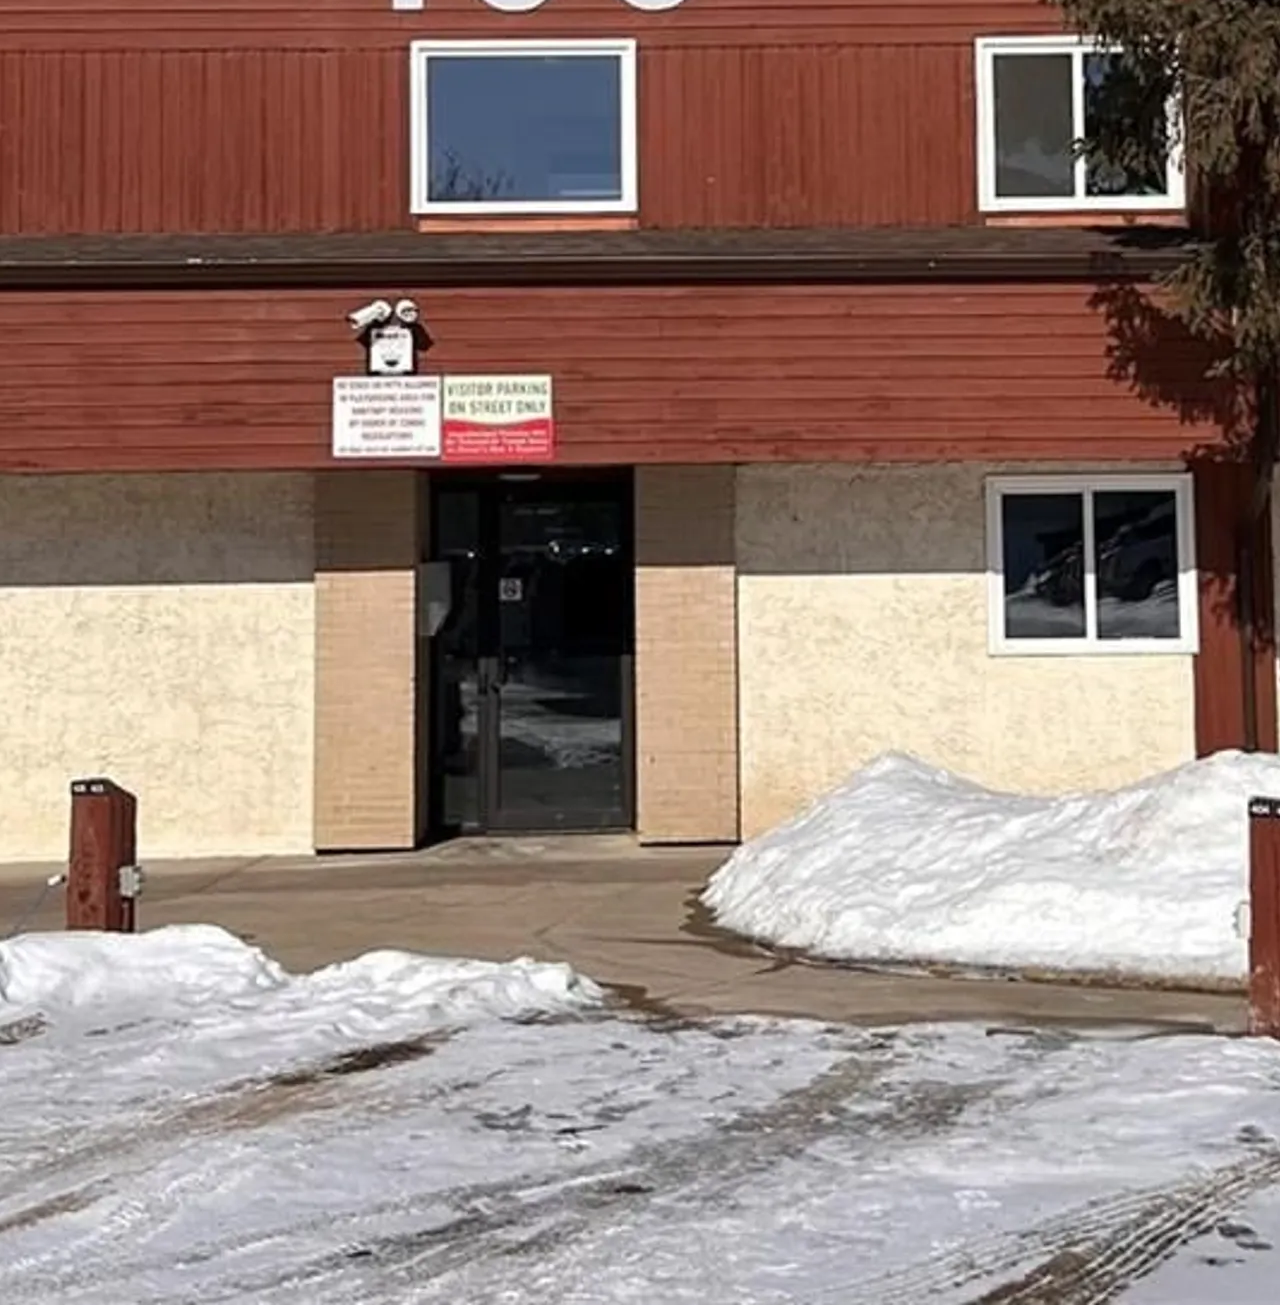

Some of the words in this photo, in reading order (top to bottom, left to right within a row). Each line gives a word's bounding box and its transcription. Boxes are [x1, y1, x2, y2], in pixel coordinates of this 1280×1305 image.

[448, 381, 493, 397] VISITOR
[496, 380, 548, 396] PARKING
[448, 399, 466, 414] ON
[469, 399, 512, 415] STREET
[516, 399, 546, 414] ONLY
